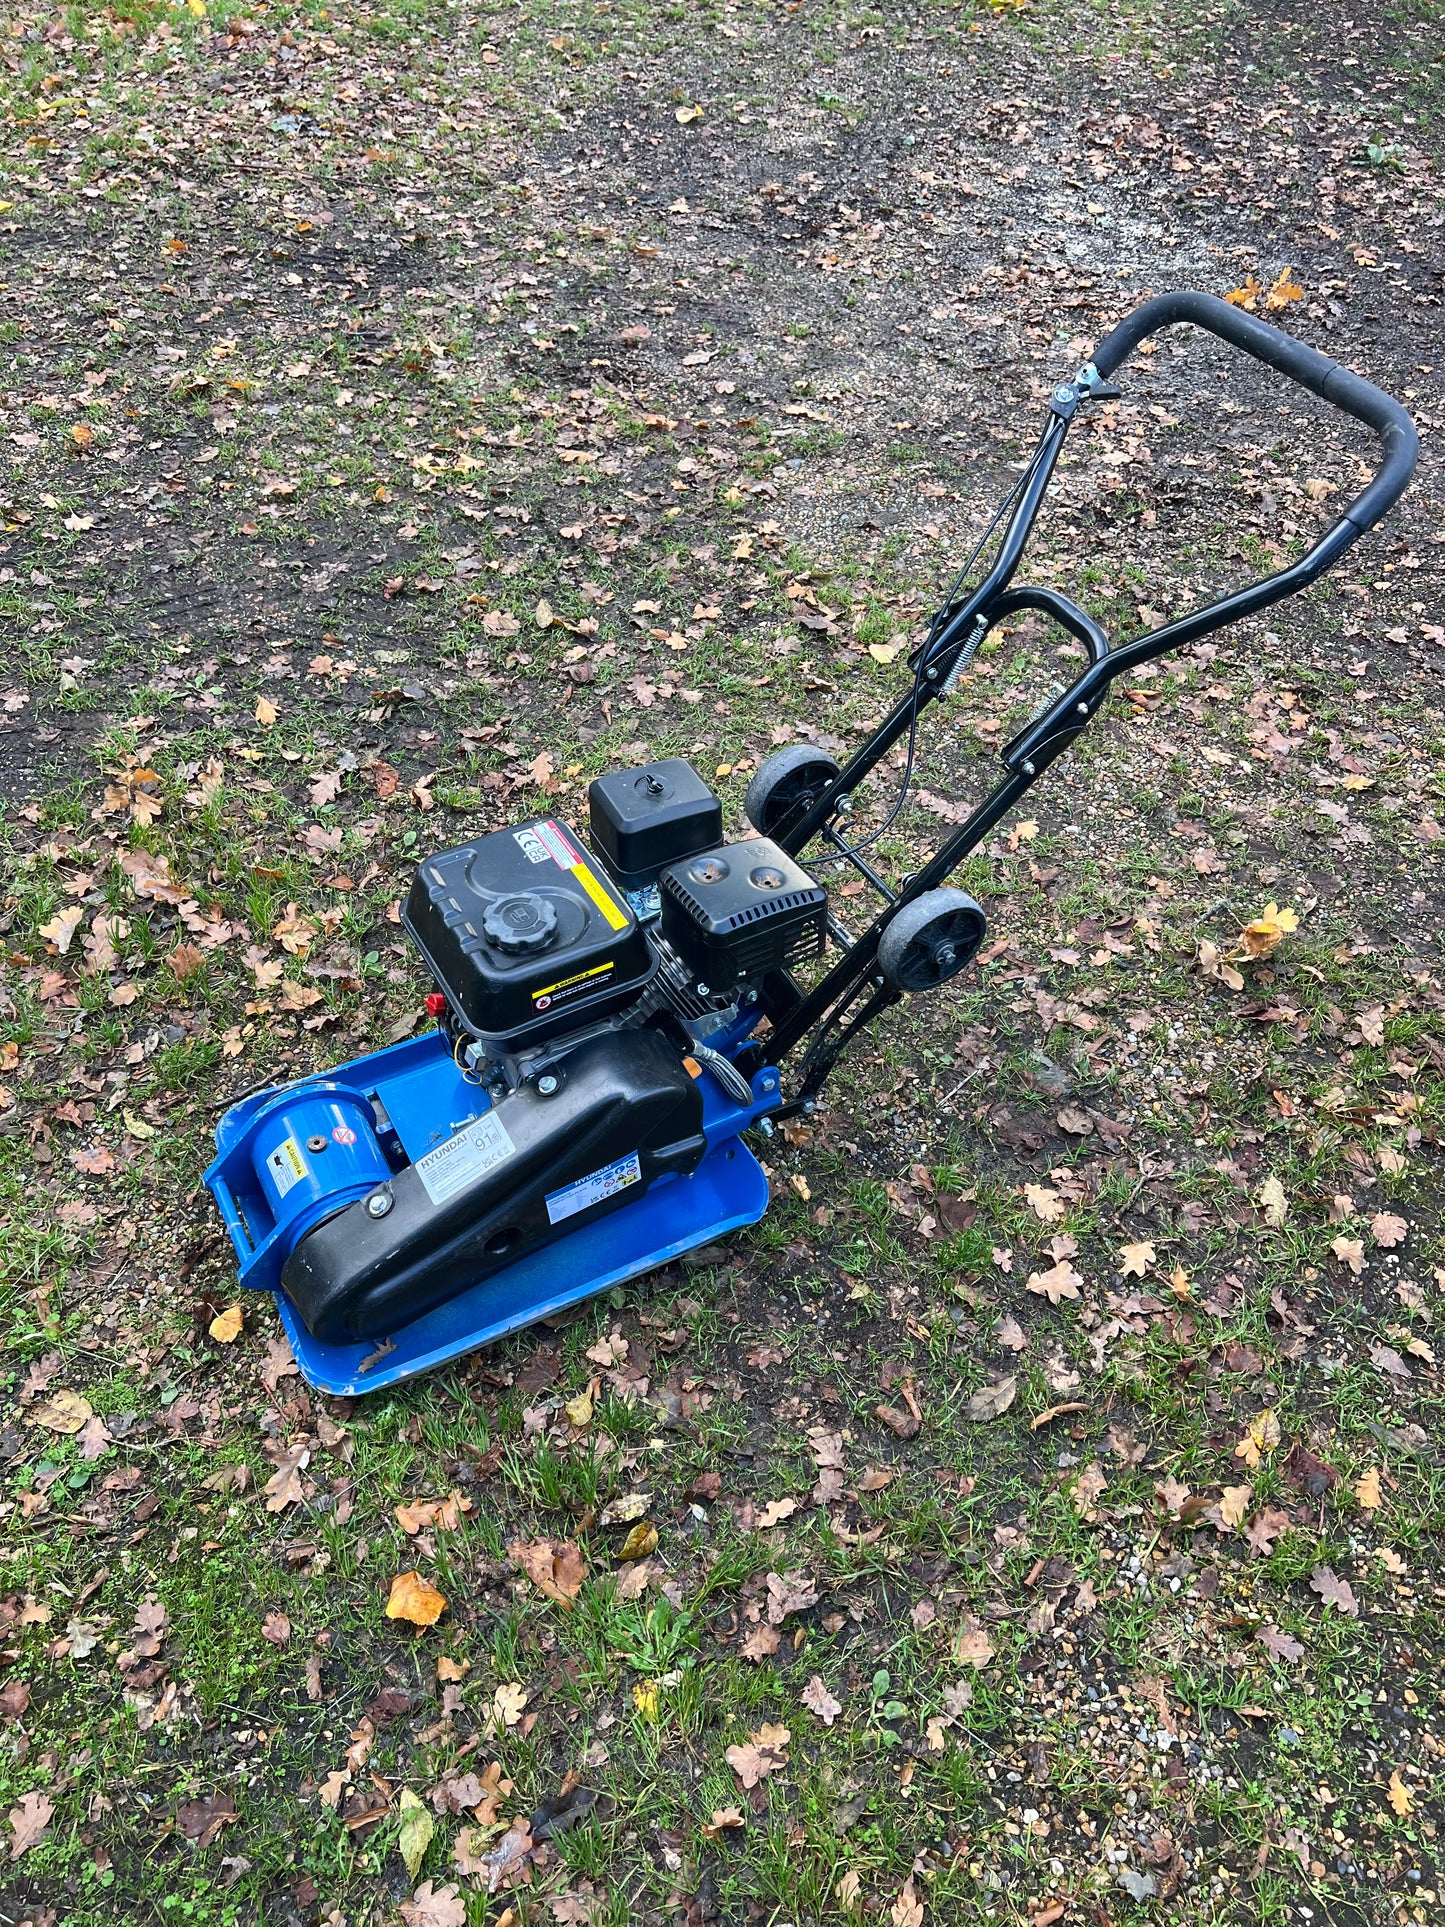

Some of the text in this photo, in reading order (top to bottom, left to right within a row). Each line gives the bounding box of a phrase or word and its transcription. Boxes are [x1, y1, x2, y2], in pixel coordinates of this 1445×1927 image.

[518, 832, 539, 848] CE
[559, 974, 584, 987] WARNING
[421, 1134, 468, 1169] HYUNDAI
[475, 1133, 493, 1151] 91
[288, 1148, 301, 1170] CAUTION
[574, 1164, 612, 1187] HYUNDAI
